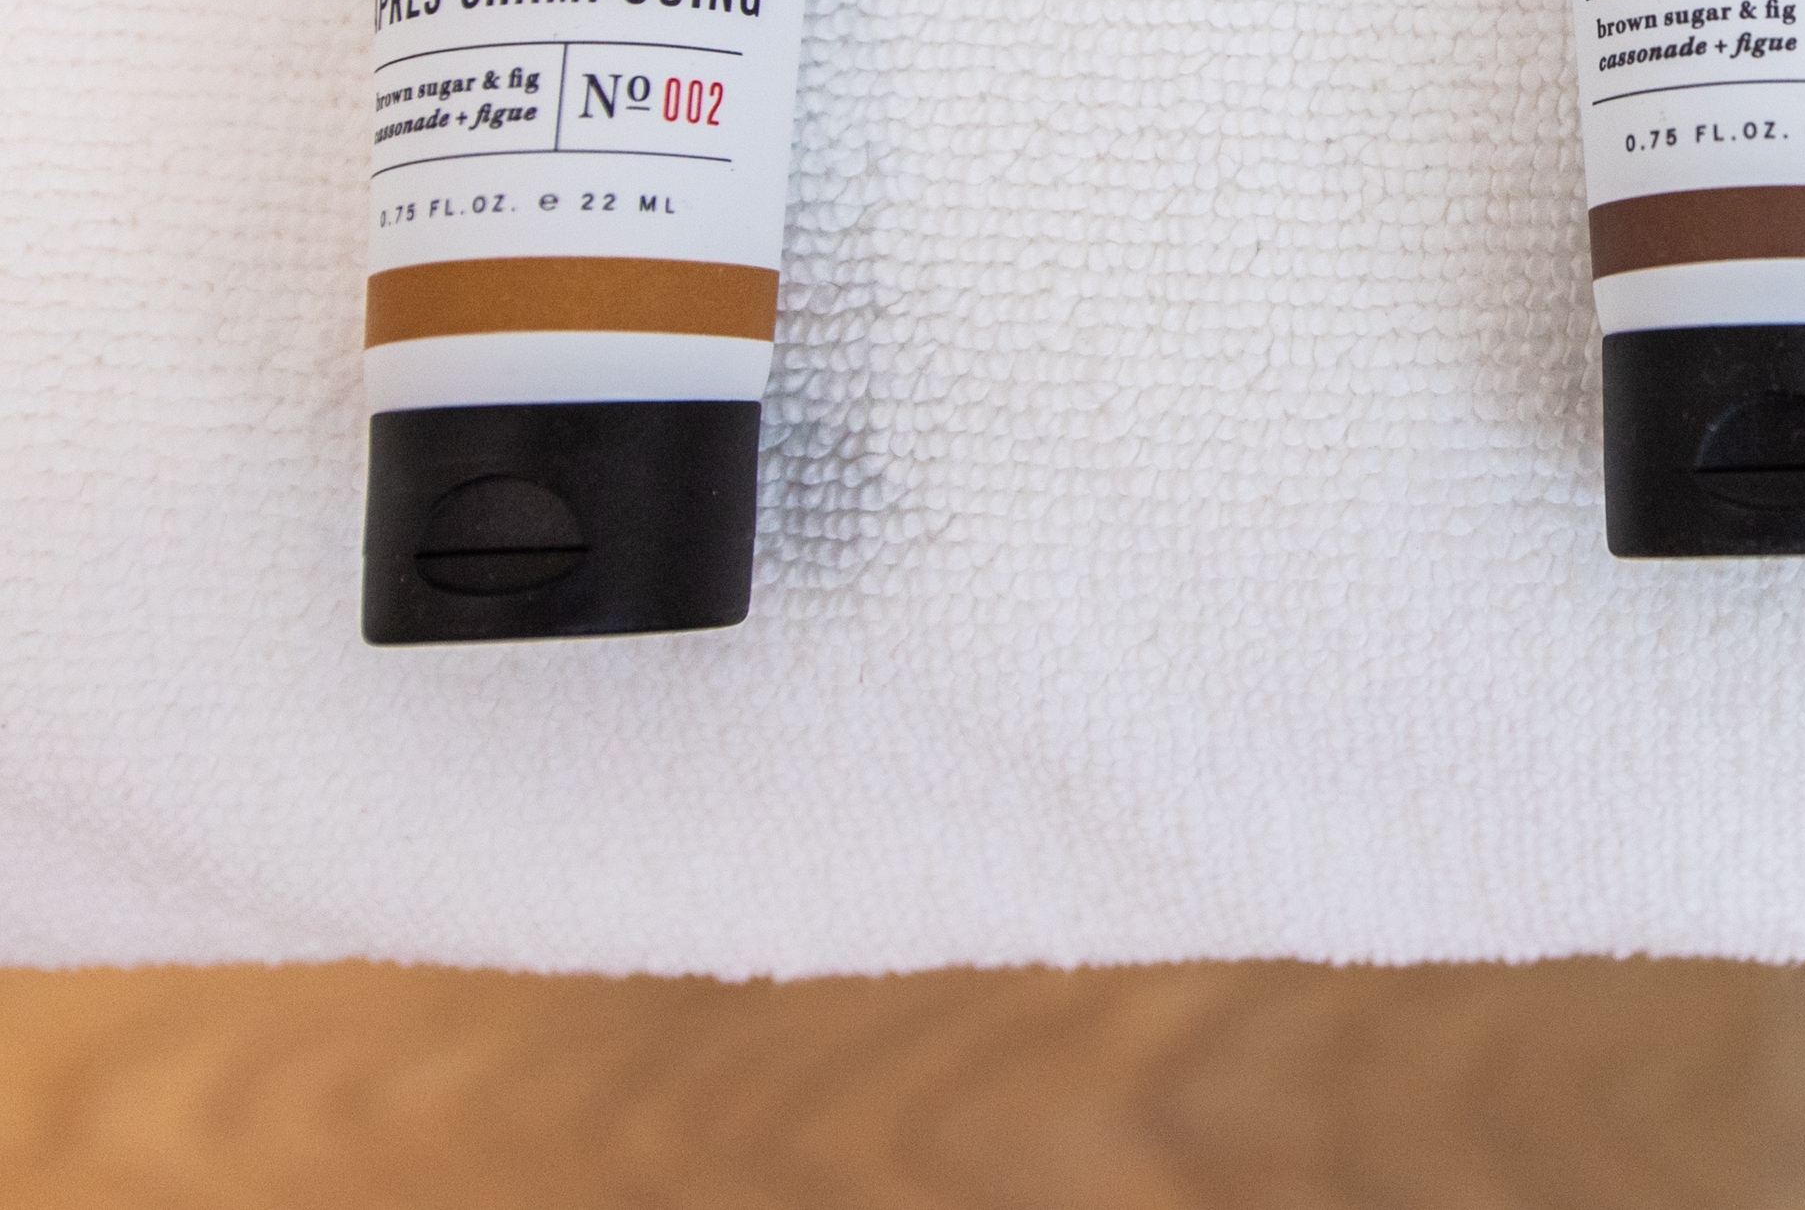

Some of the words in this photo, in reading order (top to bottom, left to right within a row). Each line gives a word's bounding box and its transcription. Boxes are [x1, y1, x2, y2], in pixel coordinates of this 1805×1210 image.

[1596, 14, 1658, 39] brown
[1663, 4, 1732, 28] sugar
[1739, 0, 1757, 20] &
[1598, 36, 1708, 72] cassonade
[1714, 39, 1728, 54] +
[1729, 31, 1797, 59] figue
[417, 75, 477, 101] sugar
[482, 70, 501, 90] &
[507, 67, 541, 94] fig
[662, 77, 724, 126] 002
[455, 111, 468, 126] +
[468, 102, 539, 131] figue
[1625, 127, 1677, 153] 0.75
[380, 203, 416, 228] 0.75
[580, 192, 617, 211] 22
[639, 195, 675, 214] ML
